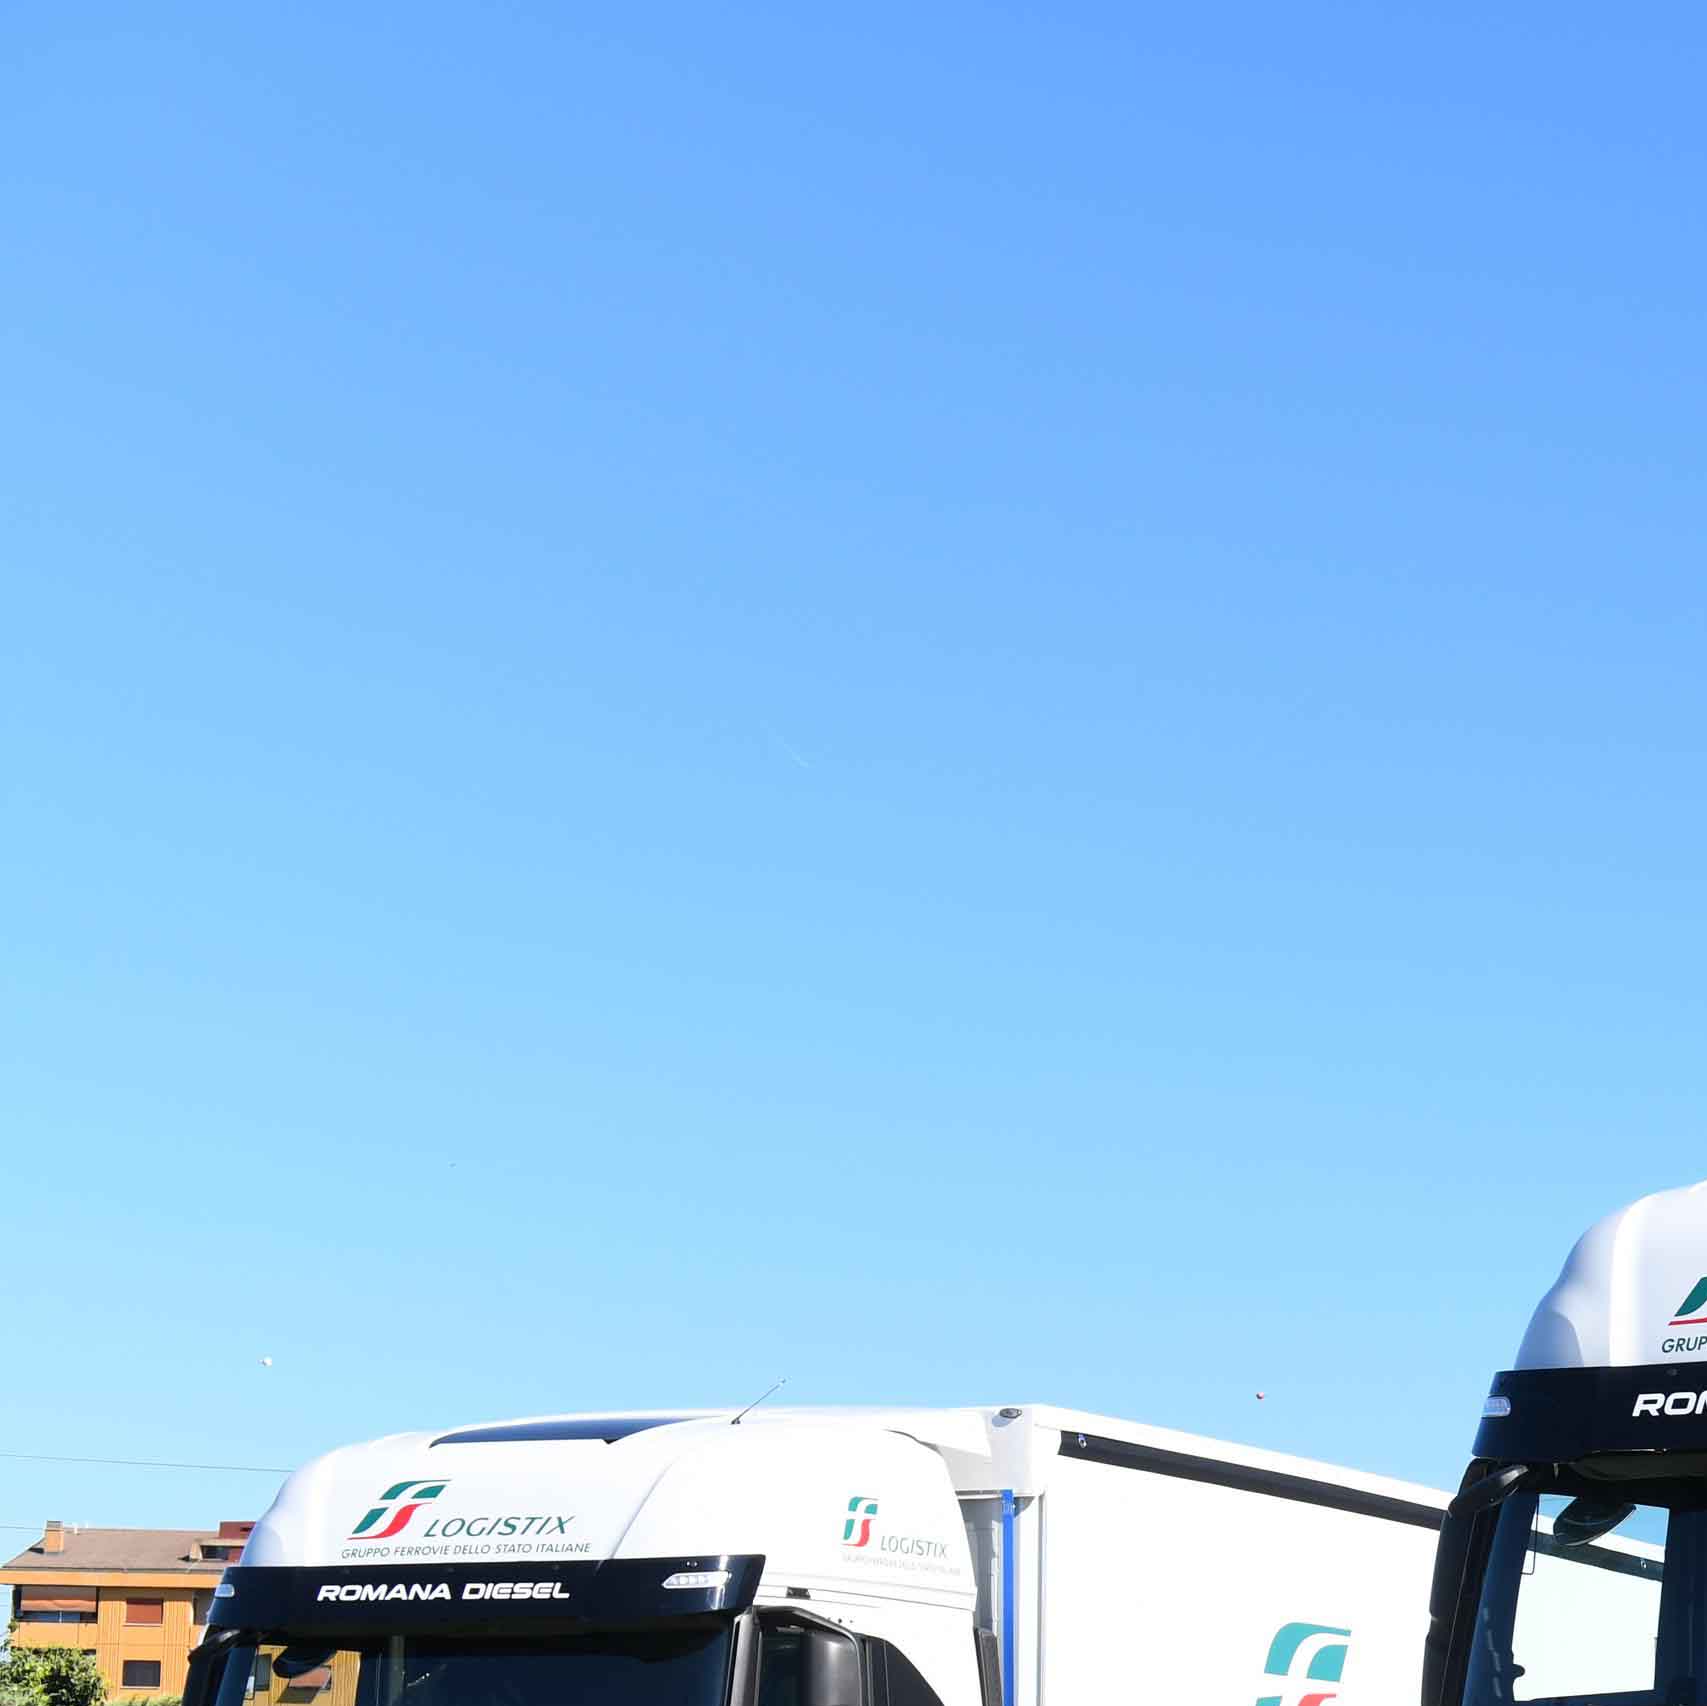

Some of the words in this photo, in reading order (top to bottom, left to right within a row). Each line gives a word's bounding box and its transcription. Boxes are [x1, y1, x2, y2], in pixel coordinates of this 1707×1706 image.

[424, 1516, 576, 1537] LOGISTIX
[341, 1546, 390, 1559] GRUPPO
[394, 1545, 450, 1557] FERROVIE
[454, 1544, 493, 1555] DELLO
[496, 1543, 533, 1555] STATO
[536, 1543, 591, 1554] ITALIANE
[880, 1535, 950, 1559] LOGISTIX
[316, 1583, 451, 1601] ROMANA
[462, 1582, 570, 1600] DIESEL
